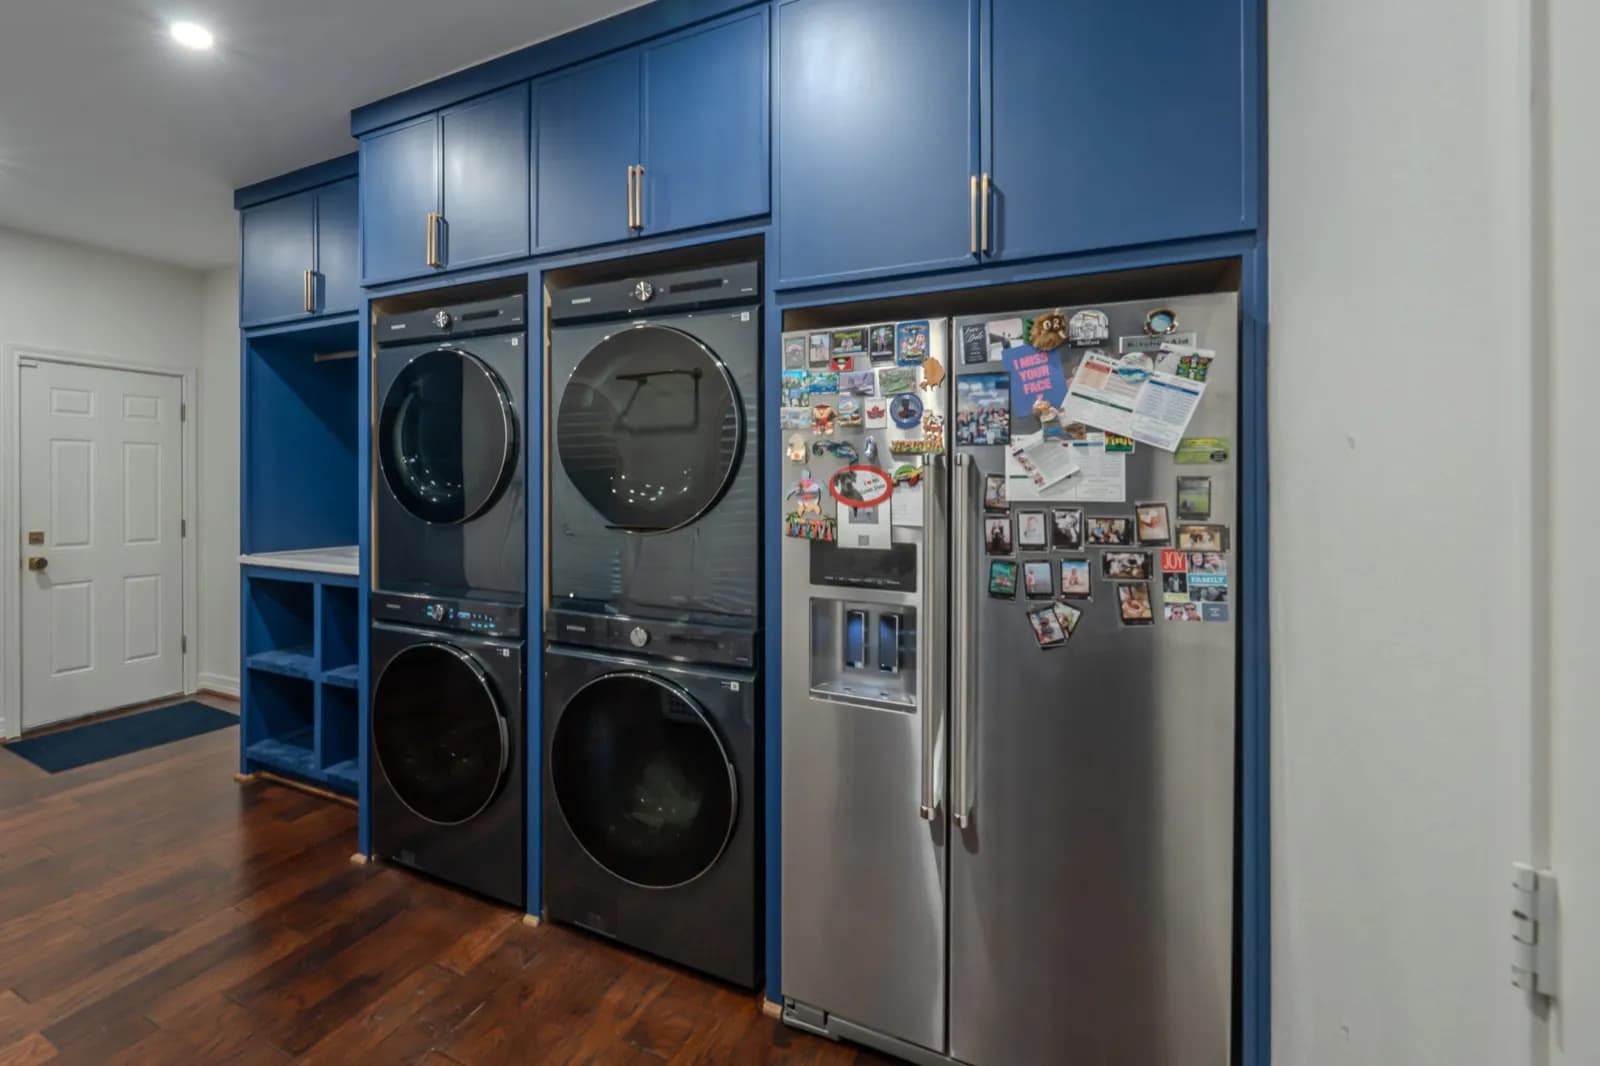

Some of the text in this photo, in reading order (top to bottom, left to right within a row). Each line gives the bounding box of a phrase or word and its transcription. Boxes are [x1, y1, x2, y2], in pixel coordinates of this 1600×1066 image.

[1013, 351, 1049, 370] I MISS
[1018, 365, 1050, 381] YOUR
[1024, 378, 1053, 395] FACE
[1163, 551, 1184, 570] JOY
